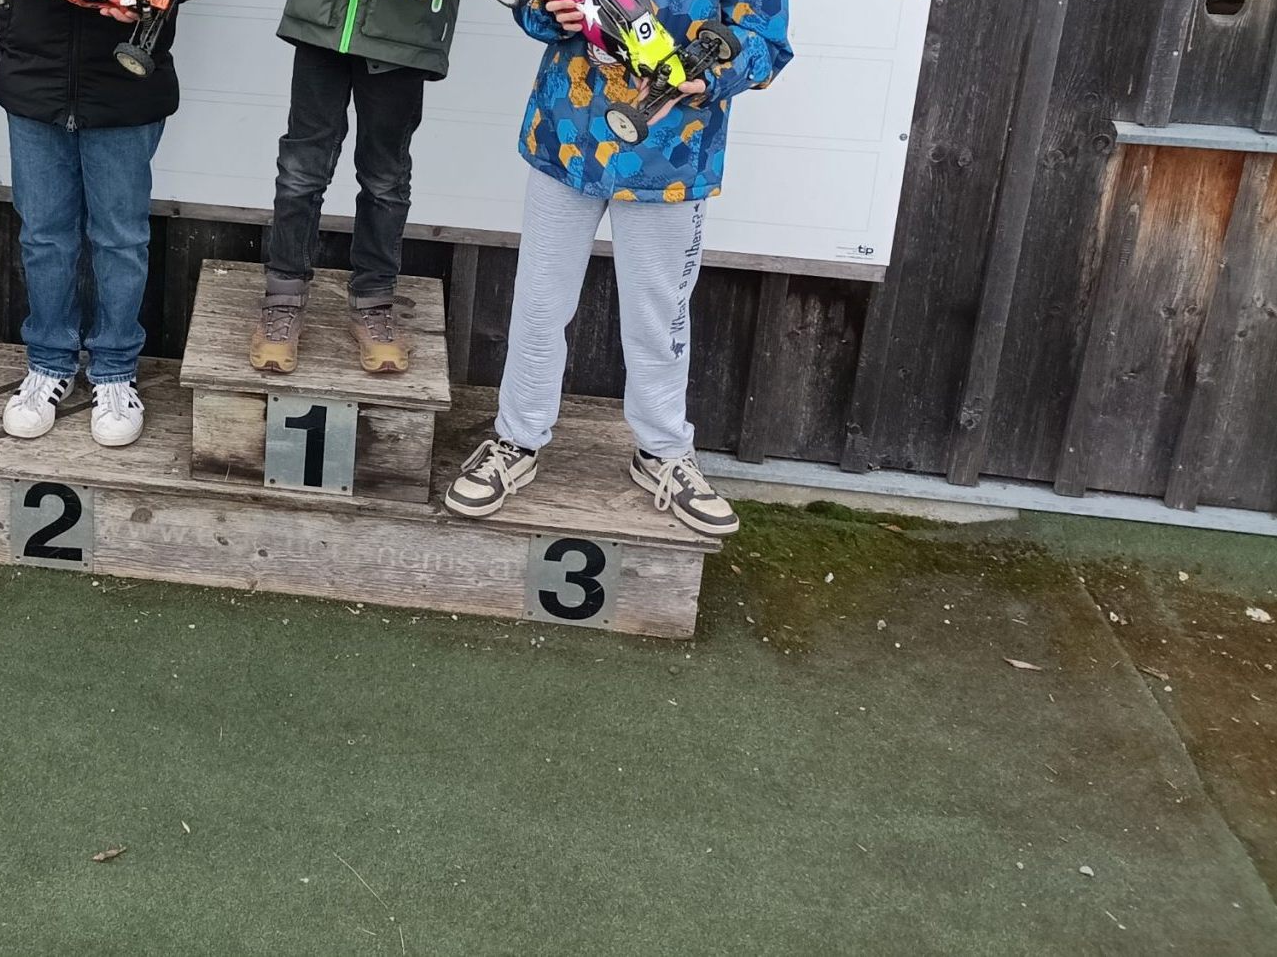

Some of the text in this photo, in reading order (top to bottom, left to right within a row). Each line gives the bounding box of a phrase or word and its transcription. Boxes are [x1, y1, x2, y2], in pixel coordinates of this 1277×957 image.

[638, 21, 652, 40] 9
[284, 404, 327, 488] 1
[23, 481, 84, 562] 2
[538, 537, 607, 621] 3
